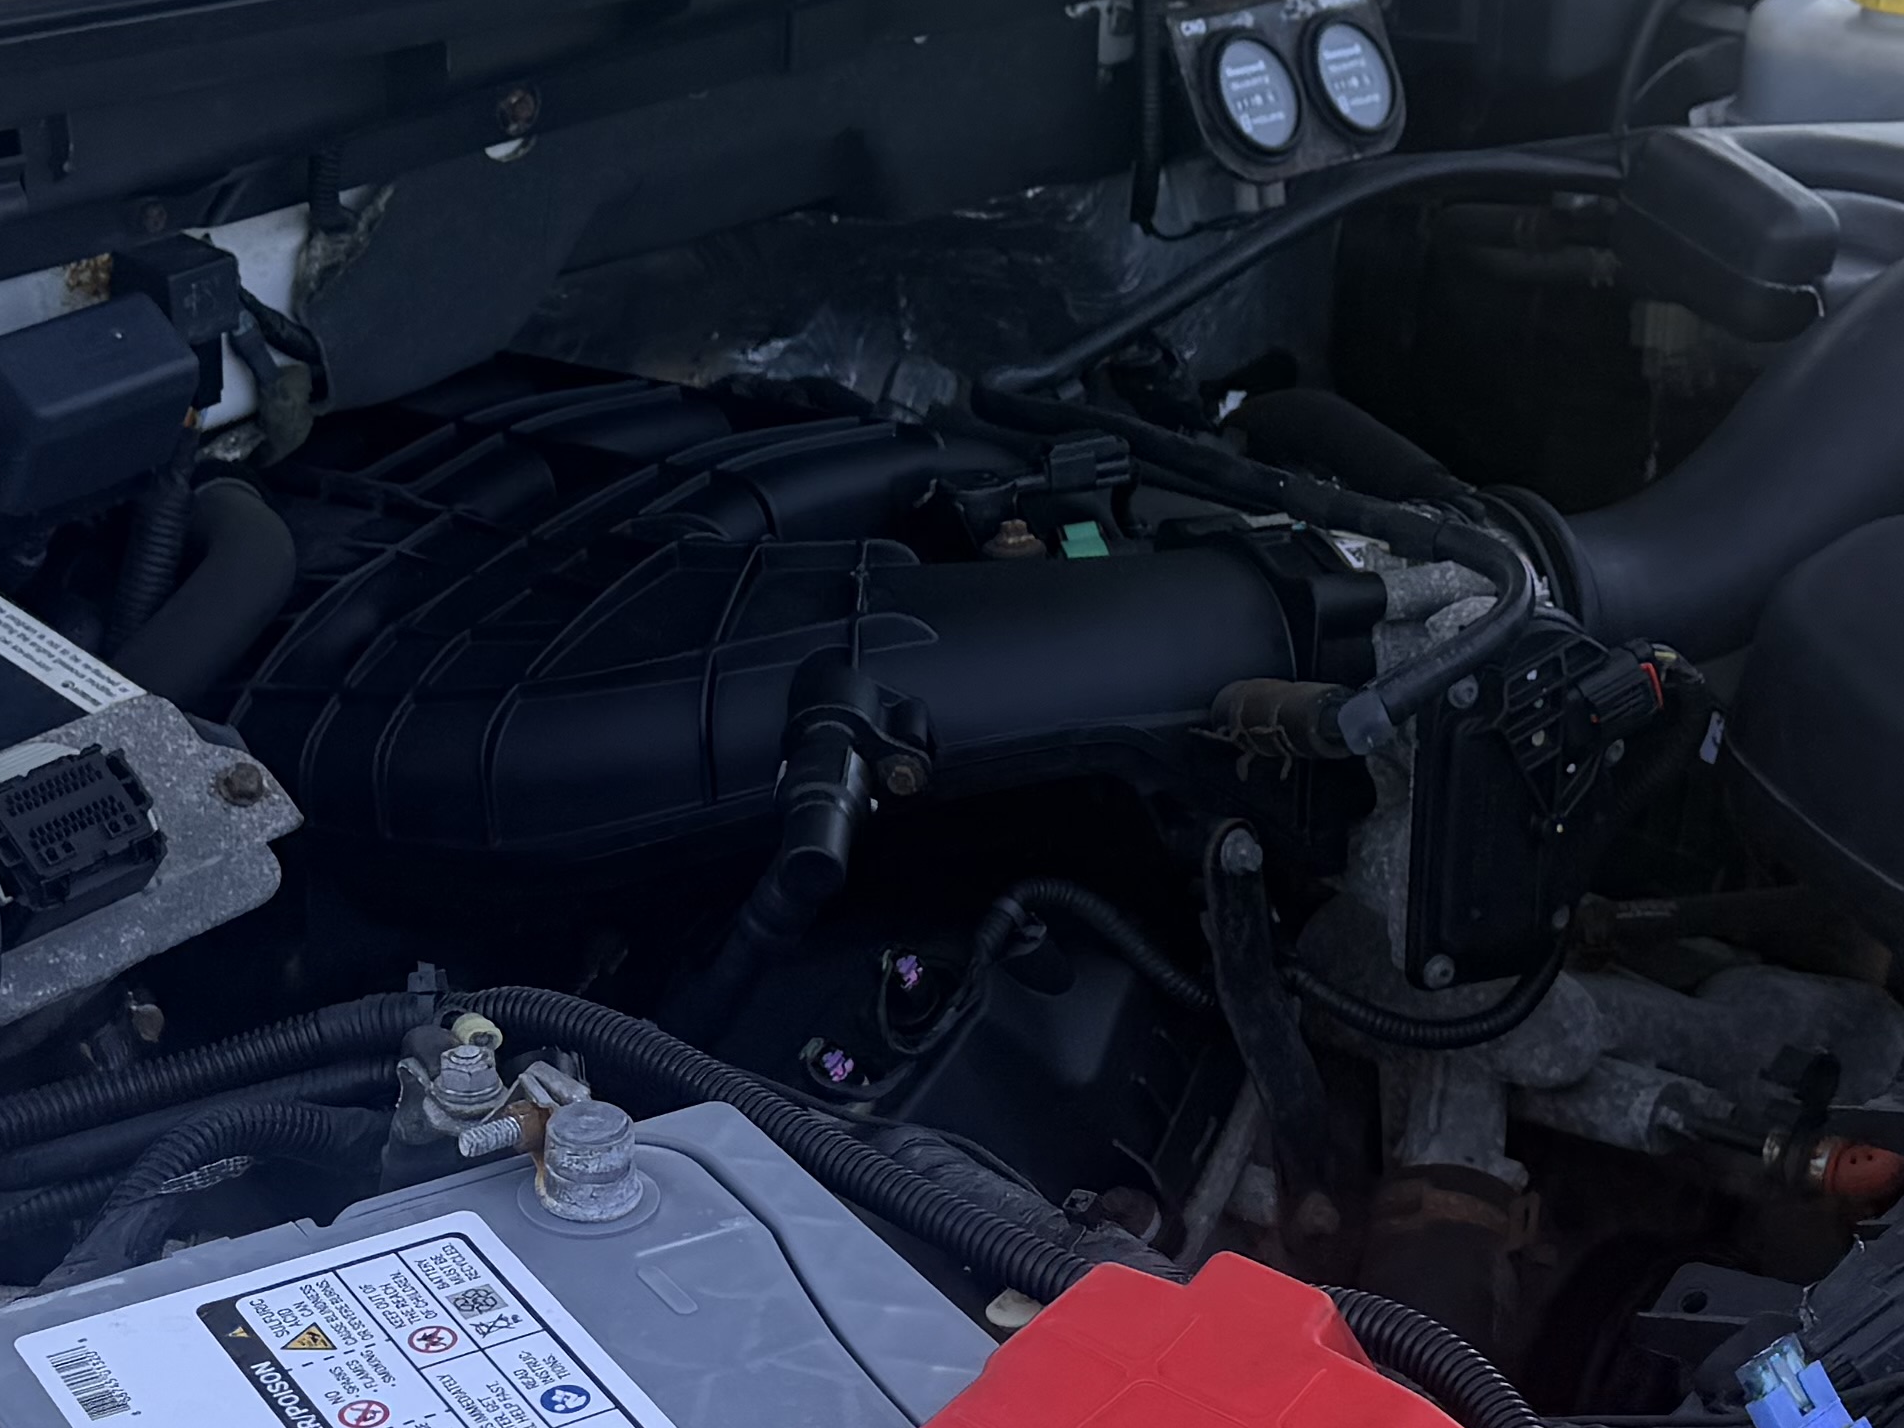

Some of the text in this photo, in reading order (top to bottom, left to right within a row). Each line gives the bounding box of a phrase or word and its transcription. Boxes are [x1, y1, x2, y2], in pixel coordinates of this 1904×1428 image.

[412, 1257, 451, 1291] BATTERY
[428, 1252, 466, 1286] MUST BE
[248, 1297, 291, 1339] SULFURIC
[275, 1306, 303, 1328] ACID
[291, 1299, 315, 1318] CAN
[357, 1283, 407, 1330] KEEP OUT OF
[377, 1281, 422, 1326] THE REACH
[327, 1365, 360, 1395] SPARKS
[344, 1358, 378, 1390] FLAMES
[358, 1348, 396, 1384] SMOKING
[511, 1367, 540, 1391] READ
[517, 1349, 556, 1386] INSTRUC-
[323, 1389, 346, 1406] NO
[435, 1373, 489, 1424] IMMEDIATELY
[475, 1395, 501, 1414] GET
[484, 1379, 512, 1403] FAST.
[501, 1401, 530, 1424] HELP
